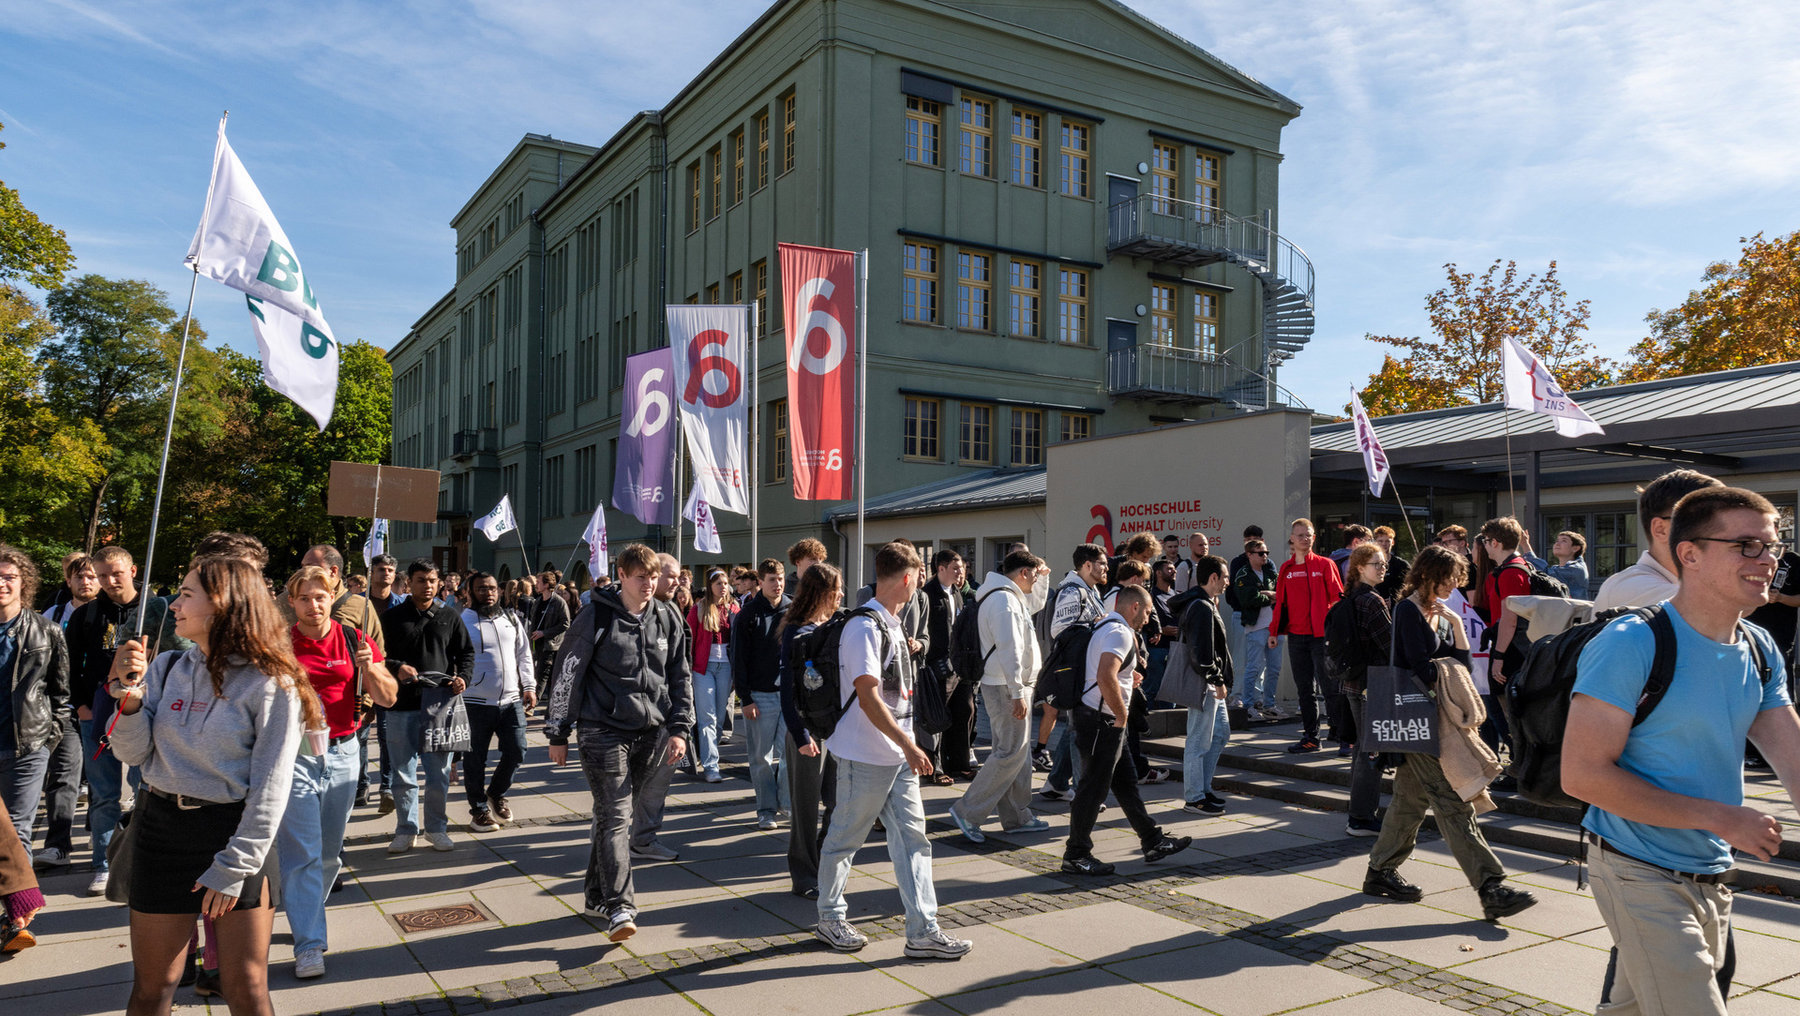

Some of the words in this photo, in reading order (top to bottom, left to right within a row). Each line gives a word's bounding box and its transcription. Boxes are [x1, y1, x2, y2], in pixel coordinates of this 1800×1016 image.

[1544, 399, 1566, 411] INS
[1120, 500, 1201, 517] HOCHSCHULE
[1120, 520, 1165, 533] ANHALT
[1167, 516, 1224, 532] University
[425, 724, 469, 737] SCHLAU
[1372, 718, 1430, 731] SCHLAU
[1372, 728, 1432, 742] BEUTEL
